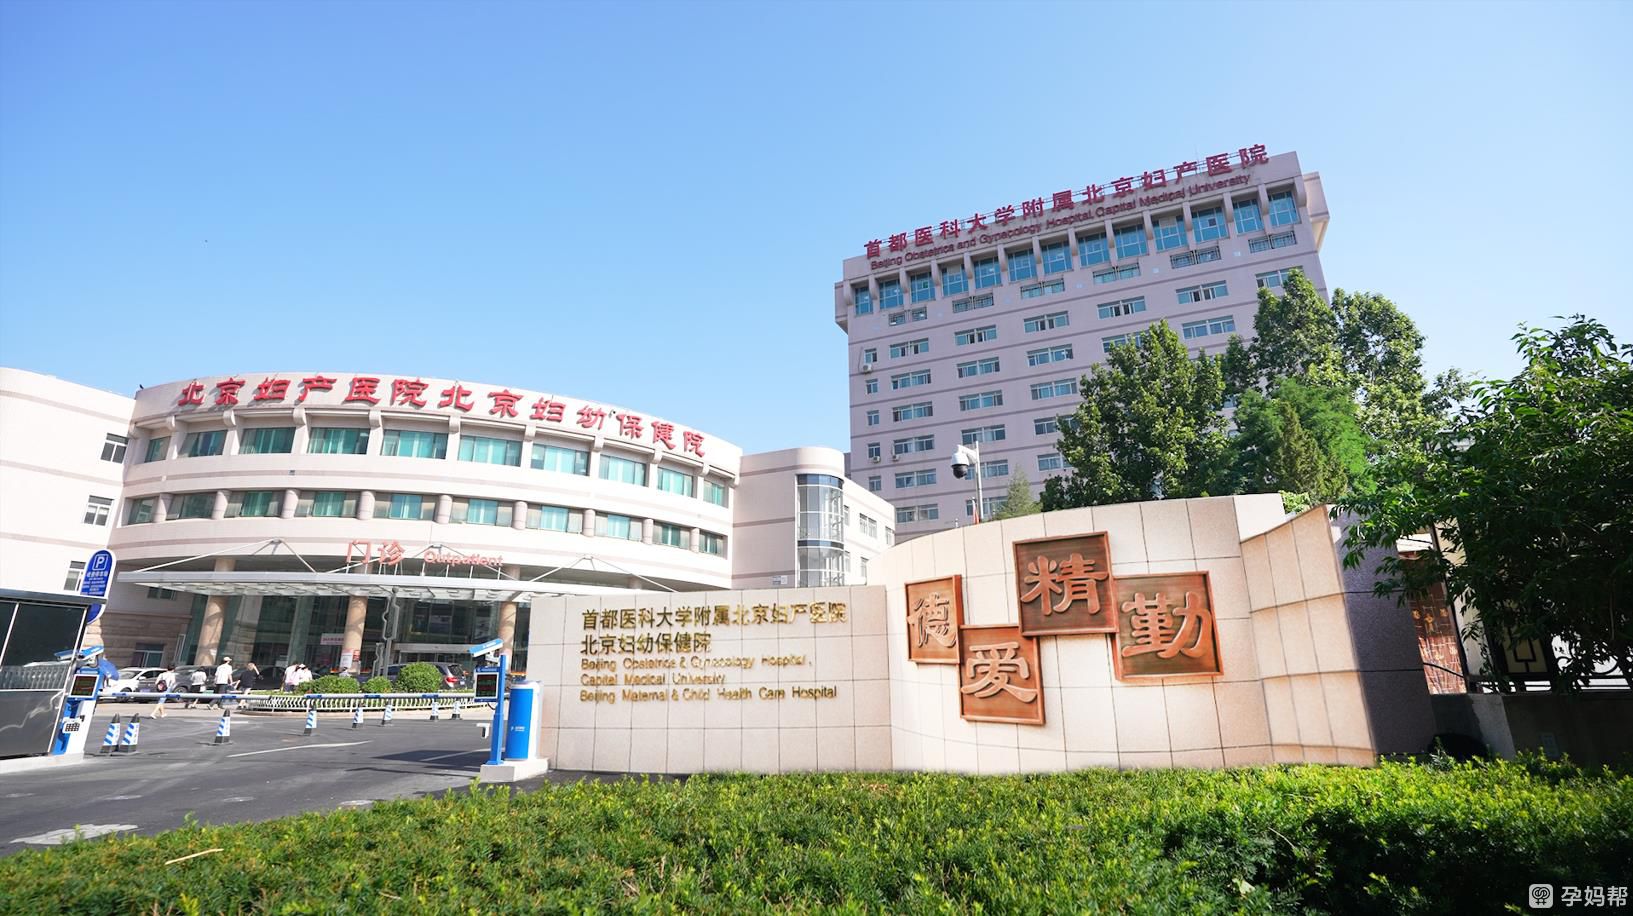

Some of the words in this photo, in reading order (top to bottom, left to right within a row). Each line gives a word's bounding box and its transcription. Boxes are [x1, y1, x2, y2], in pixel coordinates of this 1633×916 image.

[864, 144, 1269, 259] 首都医科大学附属北京妇产医院
[871, 256, 902, 270] Beijing
[957, 238, 976, 249] and
[1139, 187, 1185, 207] Medical
[1188, 173, 1251, 197] University
[346, 540, 405, 565] 门诊
[423, 550, 504, 567] Outpatient
[1021, 552, 1109, 616] 精
[582, 601, 848, 631] 首都医科大学附属北京妇产医院
[907, 591, 957, 648] 德
[1121, 591, 1212, 659] 勤
[580, 632, 712, 656] 北京妇幼保健院
[581, 658, 617, 672] Beijing
[623, 656, 676, 670] Obstetrics
[679, 656, 687, 669] &
[960, 641, 1038, 703] 爱
[580, 674, 618, 687] Capital
[624, 673, 666, 686] Medical
[672, 672, 726, 686] University
[579, 690, 616, 705] Beijing
[622, 689, 668, 702] Maternal
[671, 689, 679, 702] &
[682, 688, 710, 702] Child
[717, 687, 752, 701] Health
[758, 686, 785, 700] Care
[791, 685, 837, 701] Hospital
